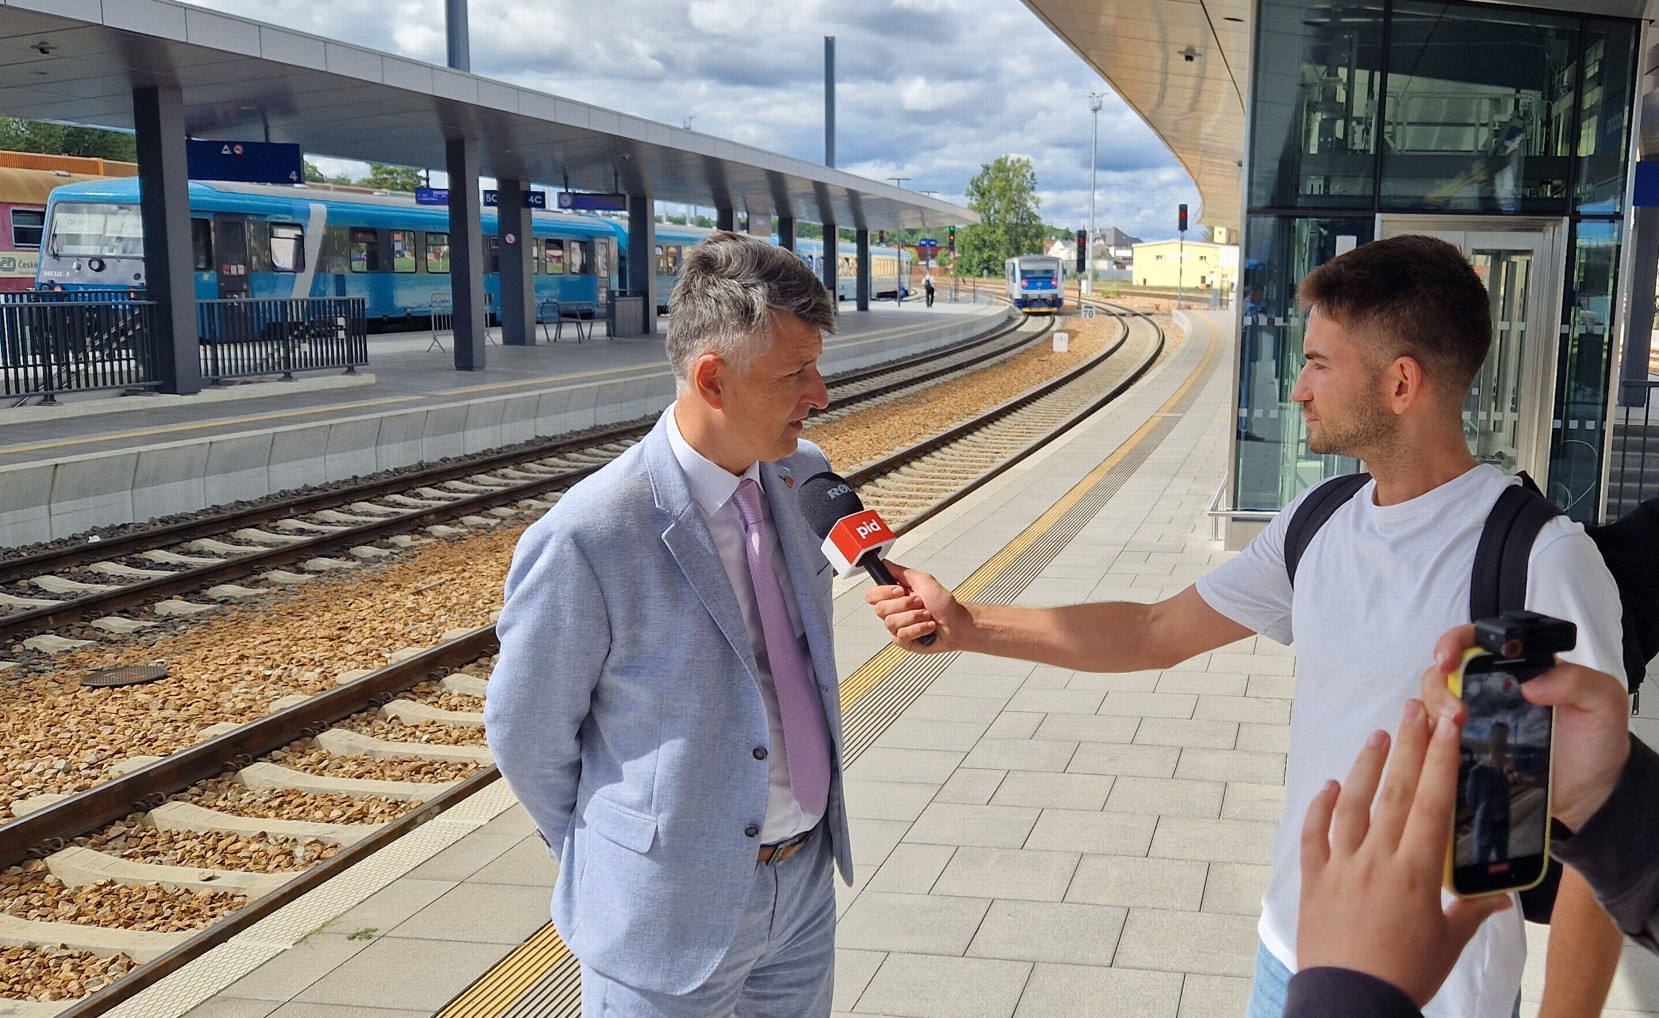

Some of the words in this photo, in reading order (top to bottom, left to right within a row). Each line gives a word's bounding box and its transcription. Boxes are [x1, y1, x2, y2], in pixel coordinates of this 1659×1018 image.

[289, 170, 298, 181] 4
[485, 194, 498, 203] 5C
[528, 195, 543, 205] 4C
[1083, 310, 1094, 319] 70
[856, 519, 881, 539] pid
